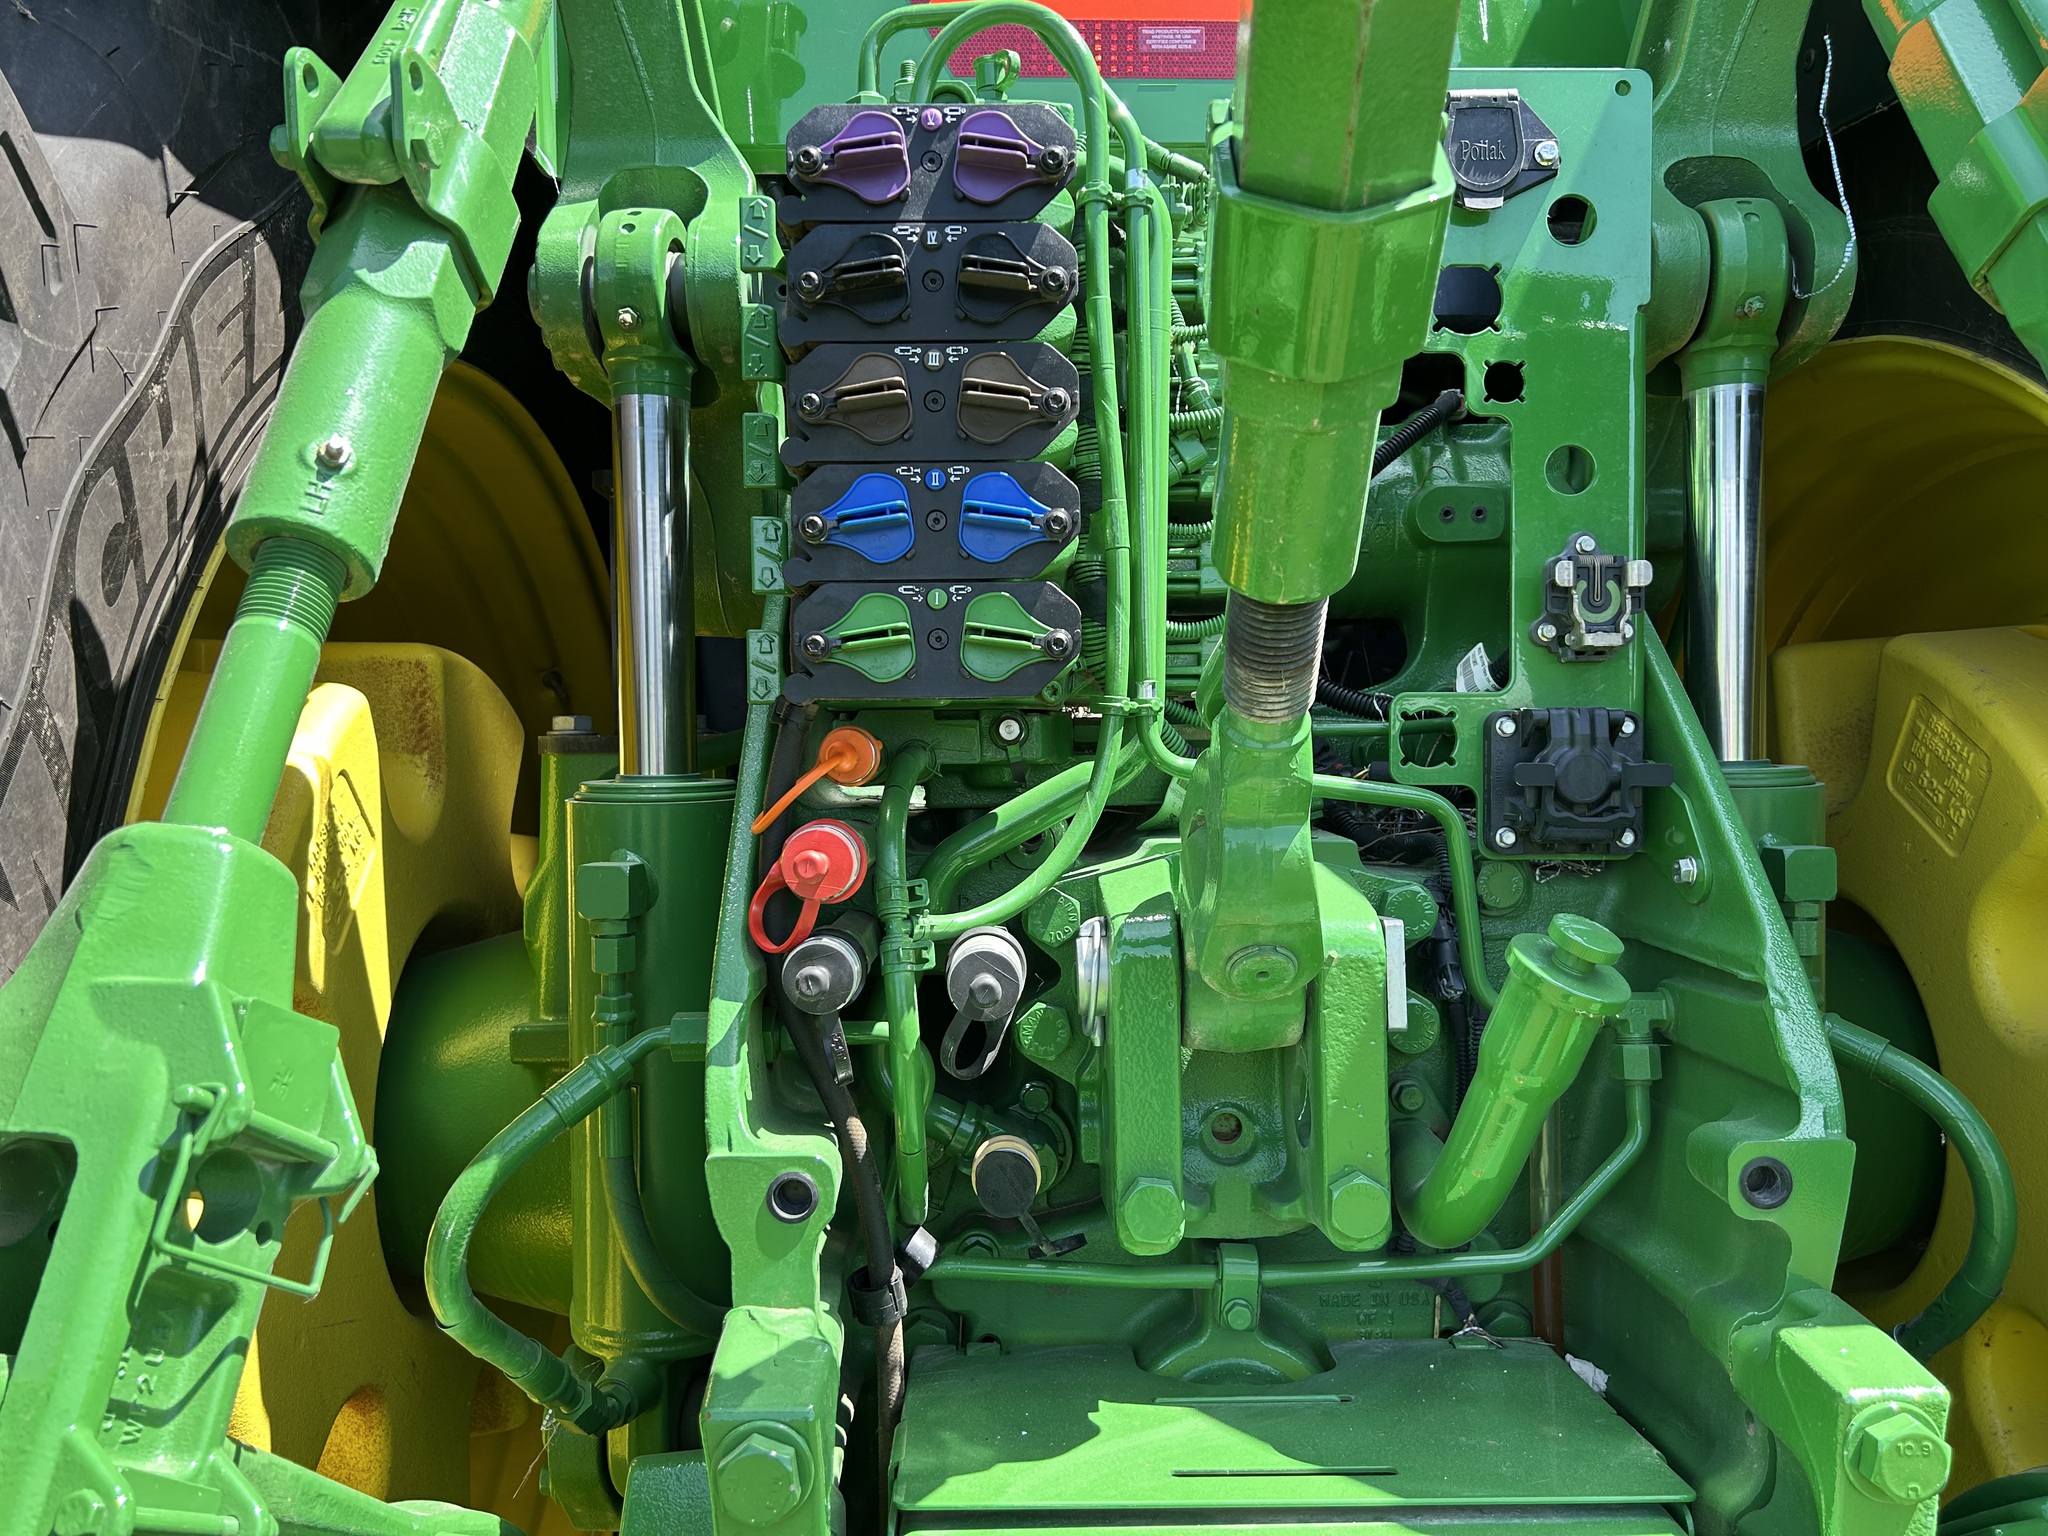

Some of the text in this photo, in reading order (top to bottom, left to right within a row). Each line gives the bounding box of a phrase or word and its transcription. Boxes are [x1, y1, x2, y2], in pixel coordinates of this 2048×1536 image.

[926, 113, 935, 126] V
[926, 230, 938, 245] IV
[928, 351, 940, 366] III
[1910, 739, 1930, 768] USA
[1918, 769, 1946, 806] 625
[1319, 1288, 1432, 1308] MADE IN USA
[1896, 1441, 1932, 1458] 10.9
